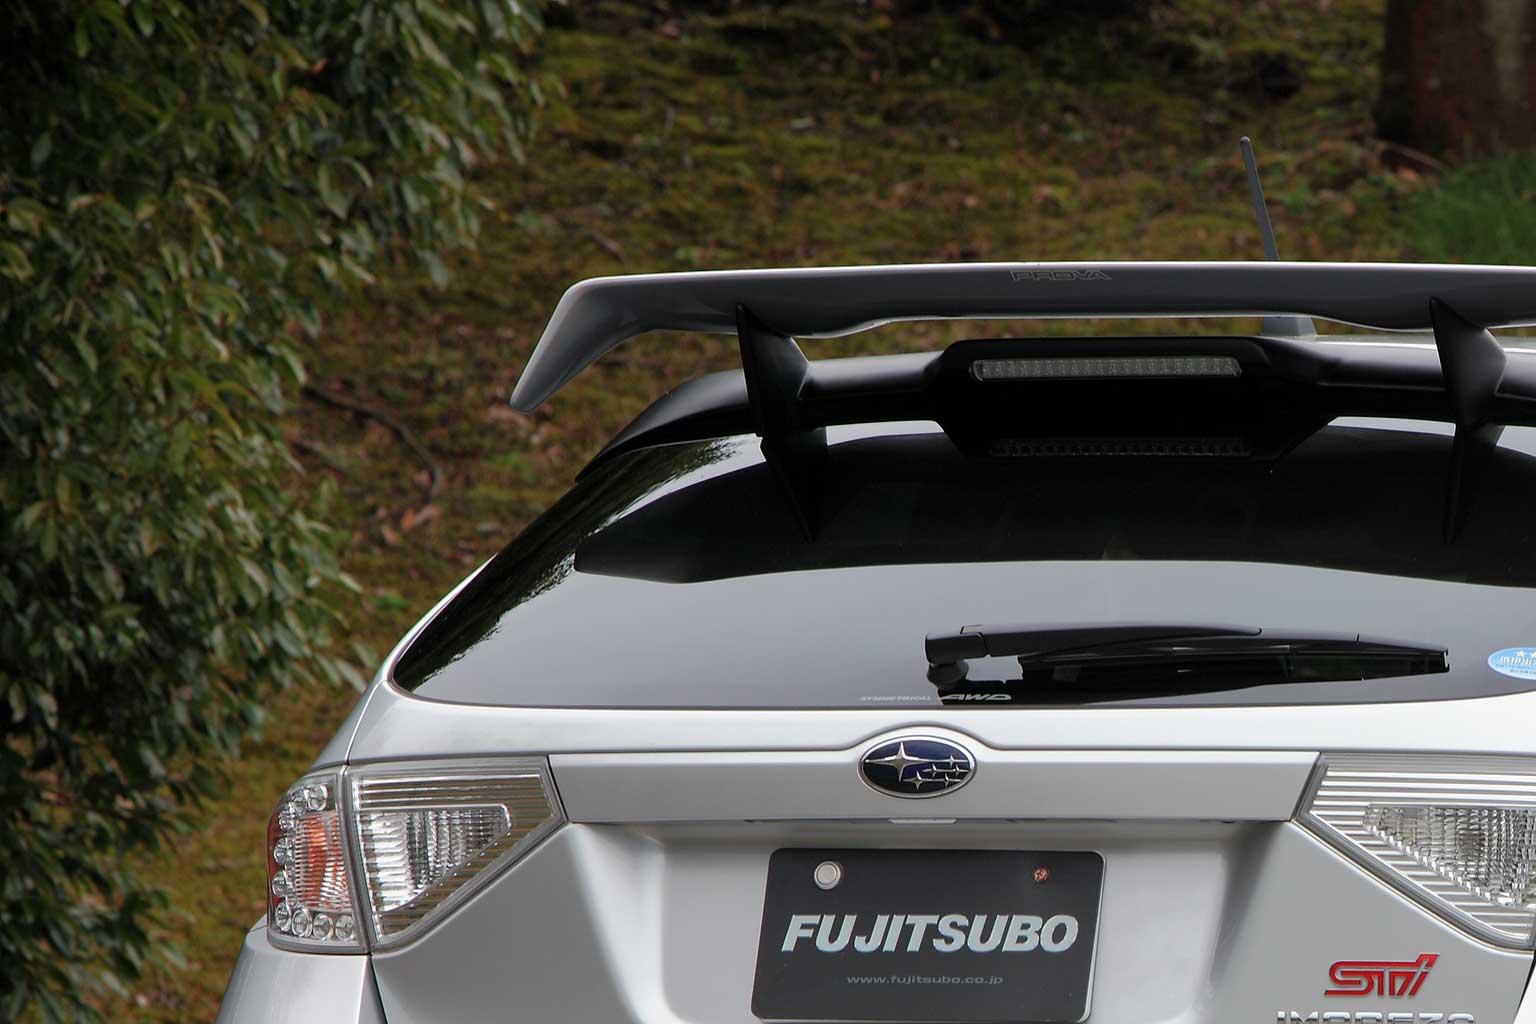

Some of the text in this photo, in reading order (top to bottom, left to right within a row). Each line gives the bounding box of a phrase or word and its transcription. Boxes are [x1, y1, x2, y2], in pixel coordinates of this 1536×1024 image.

[938, 692, 1013, 701] AWD
[781, 914, 1079, 953] FUJITSUBO
[847, 974, 1003, 985] www.fujitsubo.co.jp
